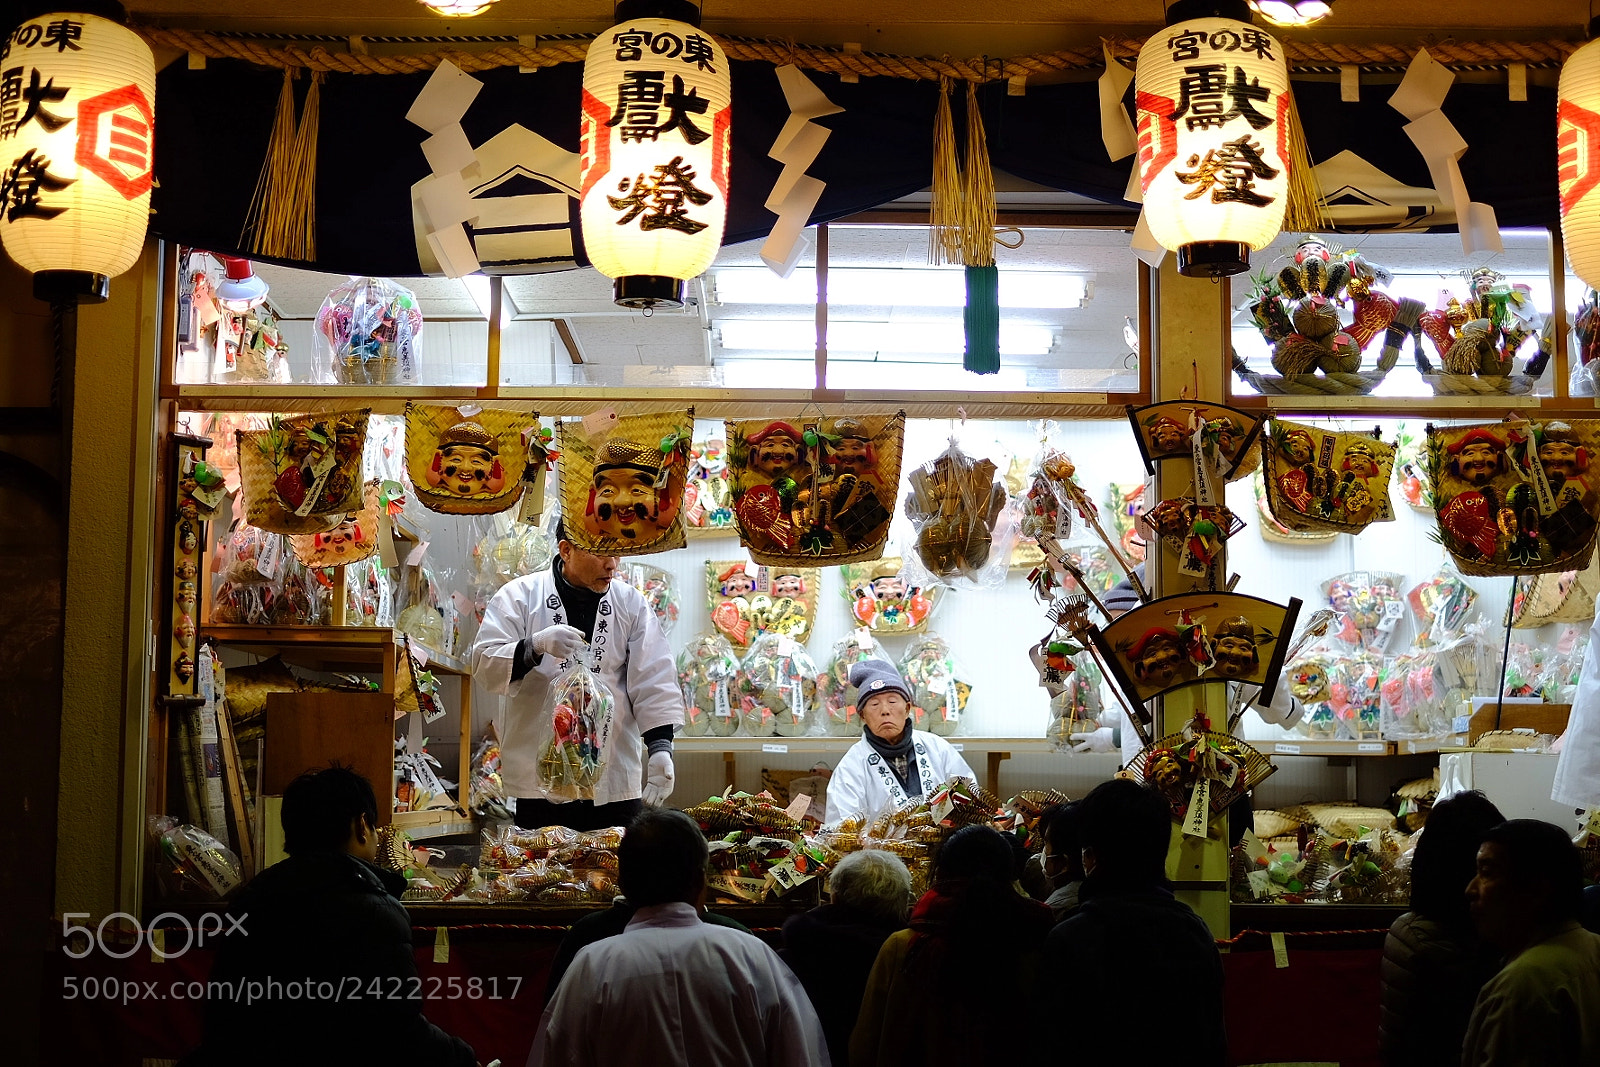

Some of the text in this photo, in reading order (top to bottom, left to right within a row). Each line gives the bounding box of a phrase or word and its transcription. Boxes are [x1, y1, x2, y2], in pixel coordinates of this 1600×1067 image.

[612, 28, 716, 74] 東の宮
[1167, 27, 1276, 62] 東の宮
